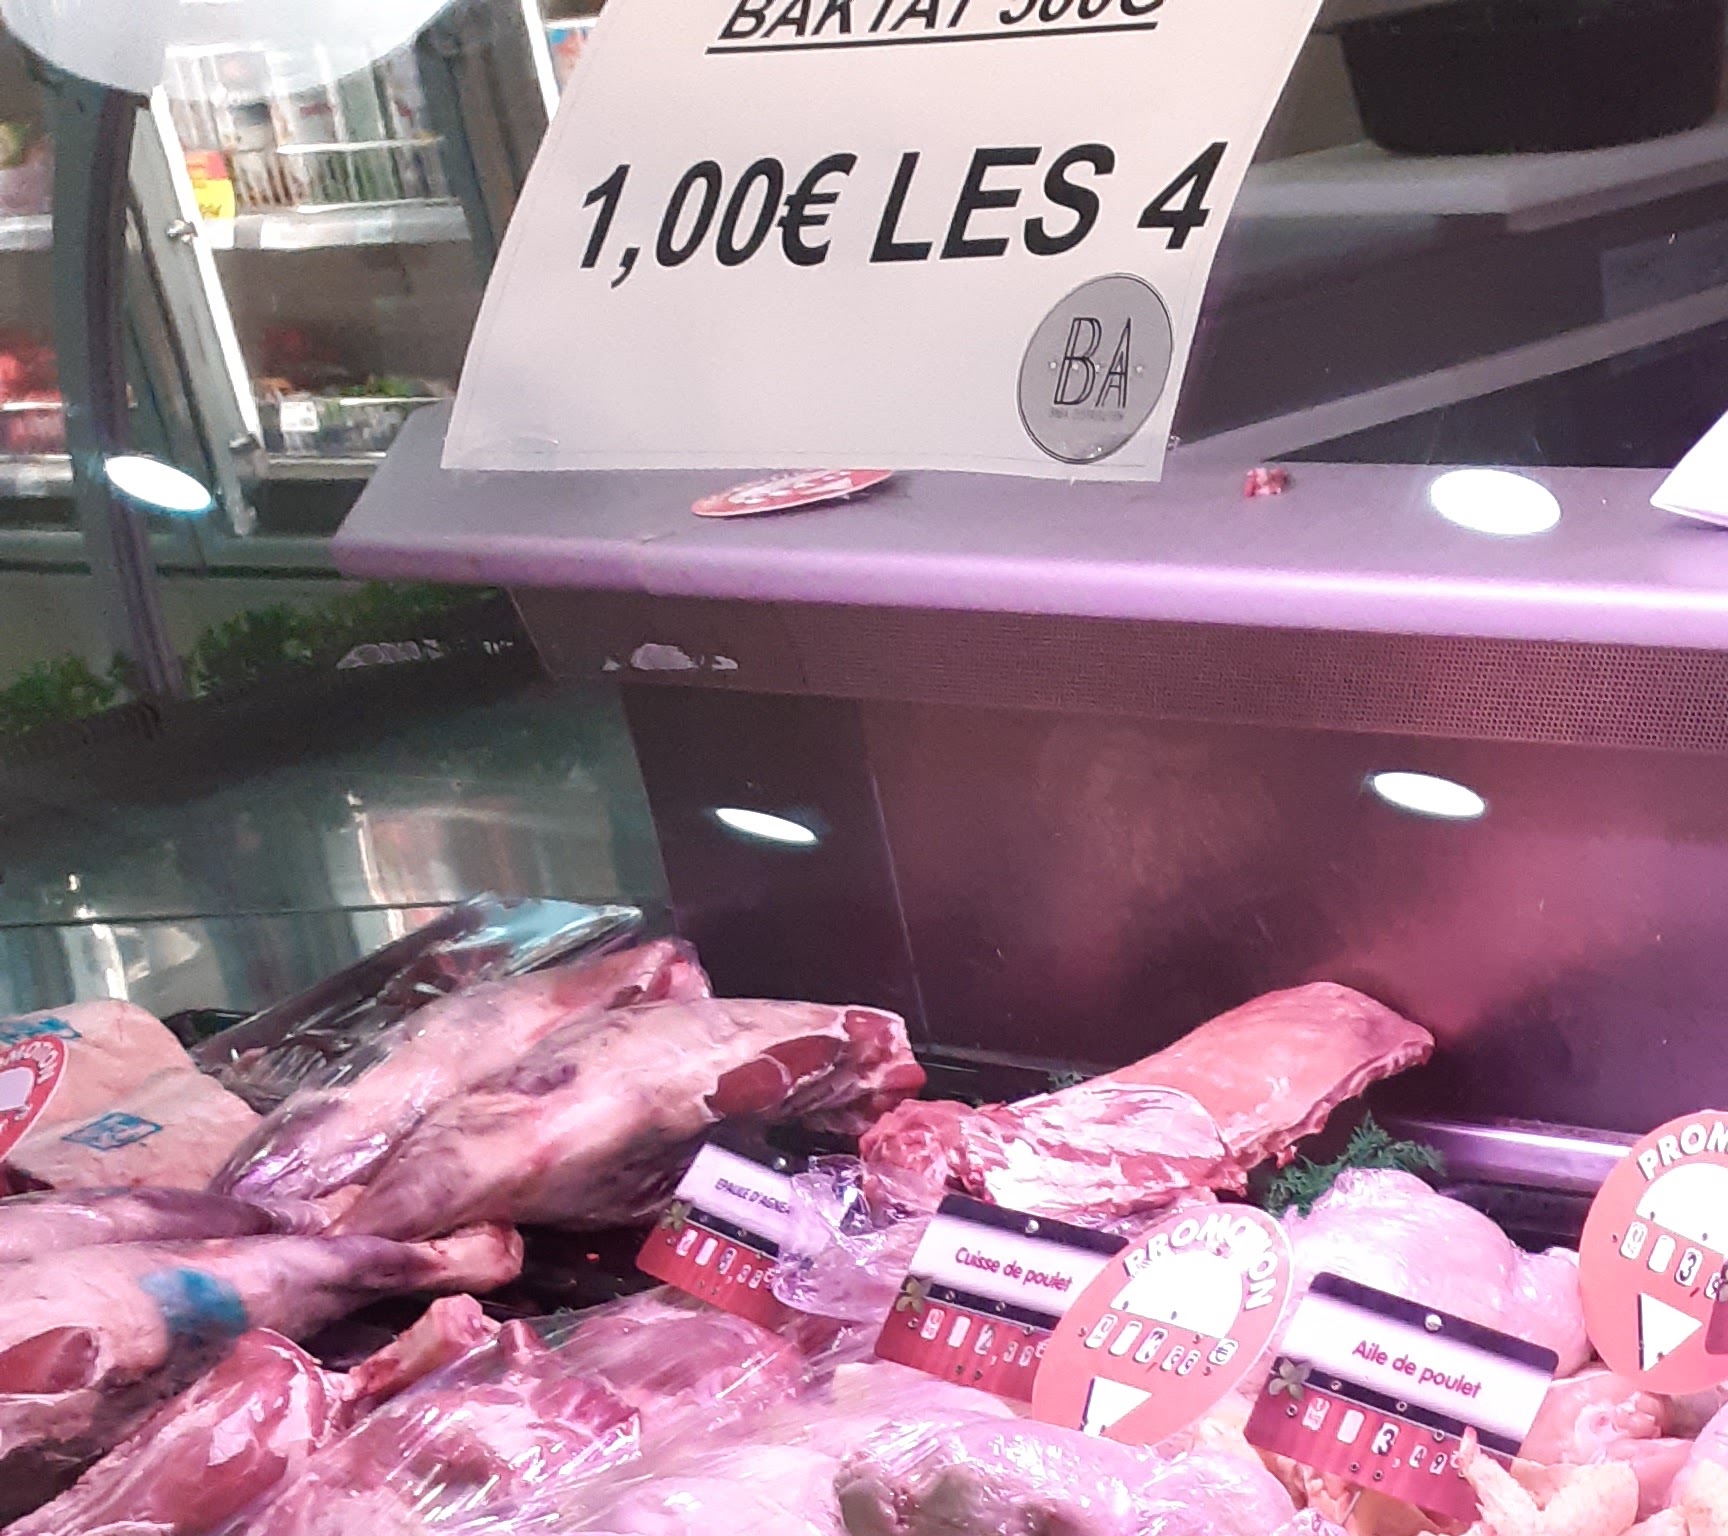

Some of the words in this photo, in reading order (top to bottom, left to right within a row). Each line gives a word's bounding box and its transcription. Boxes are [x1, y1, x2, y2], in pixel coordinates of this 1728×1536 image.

[580, 153, 857, 289] 1,00€
[869, 142, 1118, 263] LES
[1138, 140, 1228, 251] 4
[1053, 317, 1132, 409] BA
[955, 1247, 1000, 1273] Cuisse
[1003, 1259, 1023, 1279] de
[1022, 1267, 1073, 1293] poulet
[1352, 1340, 1388, 1366] Aile
[1392, 1354, 1417, 1376] de
[1418, 1365, 1482, 1398] poulet
